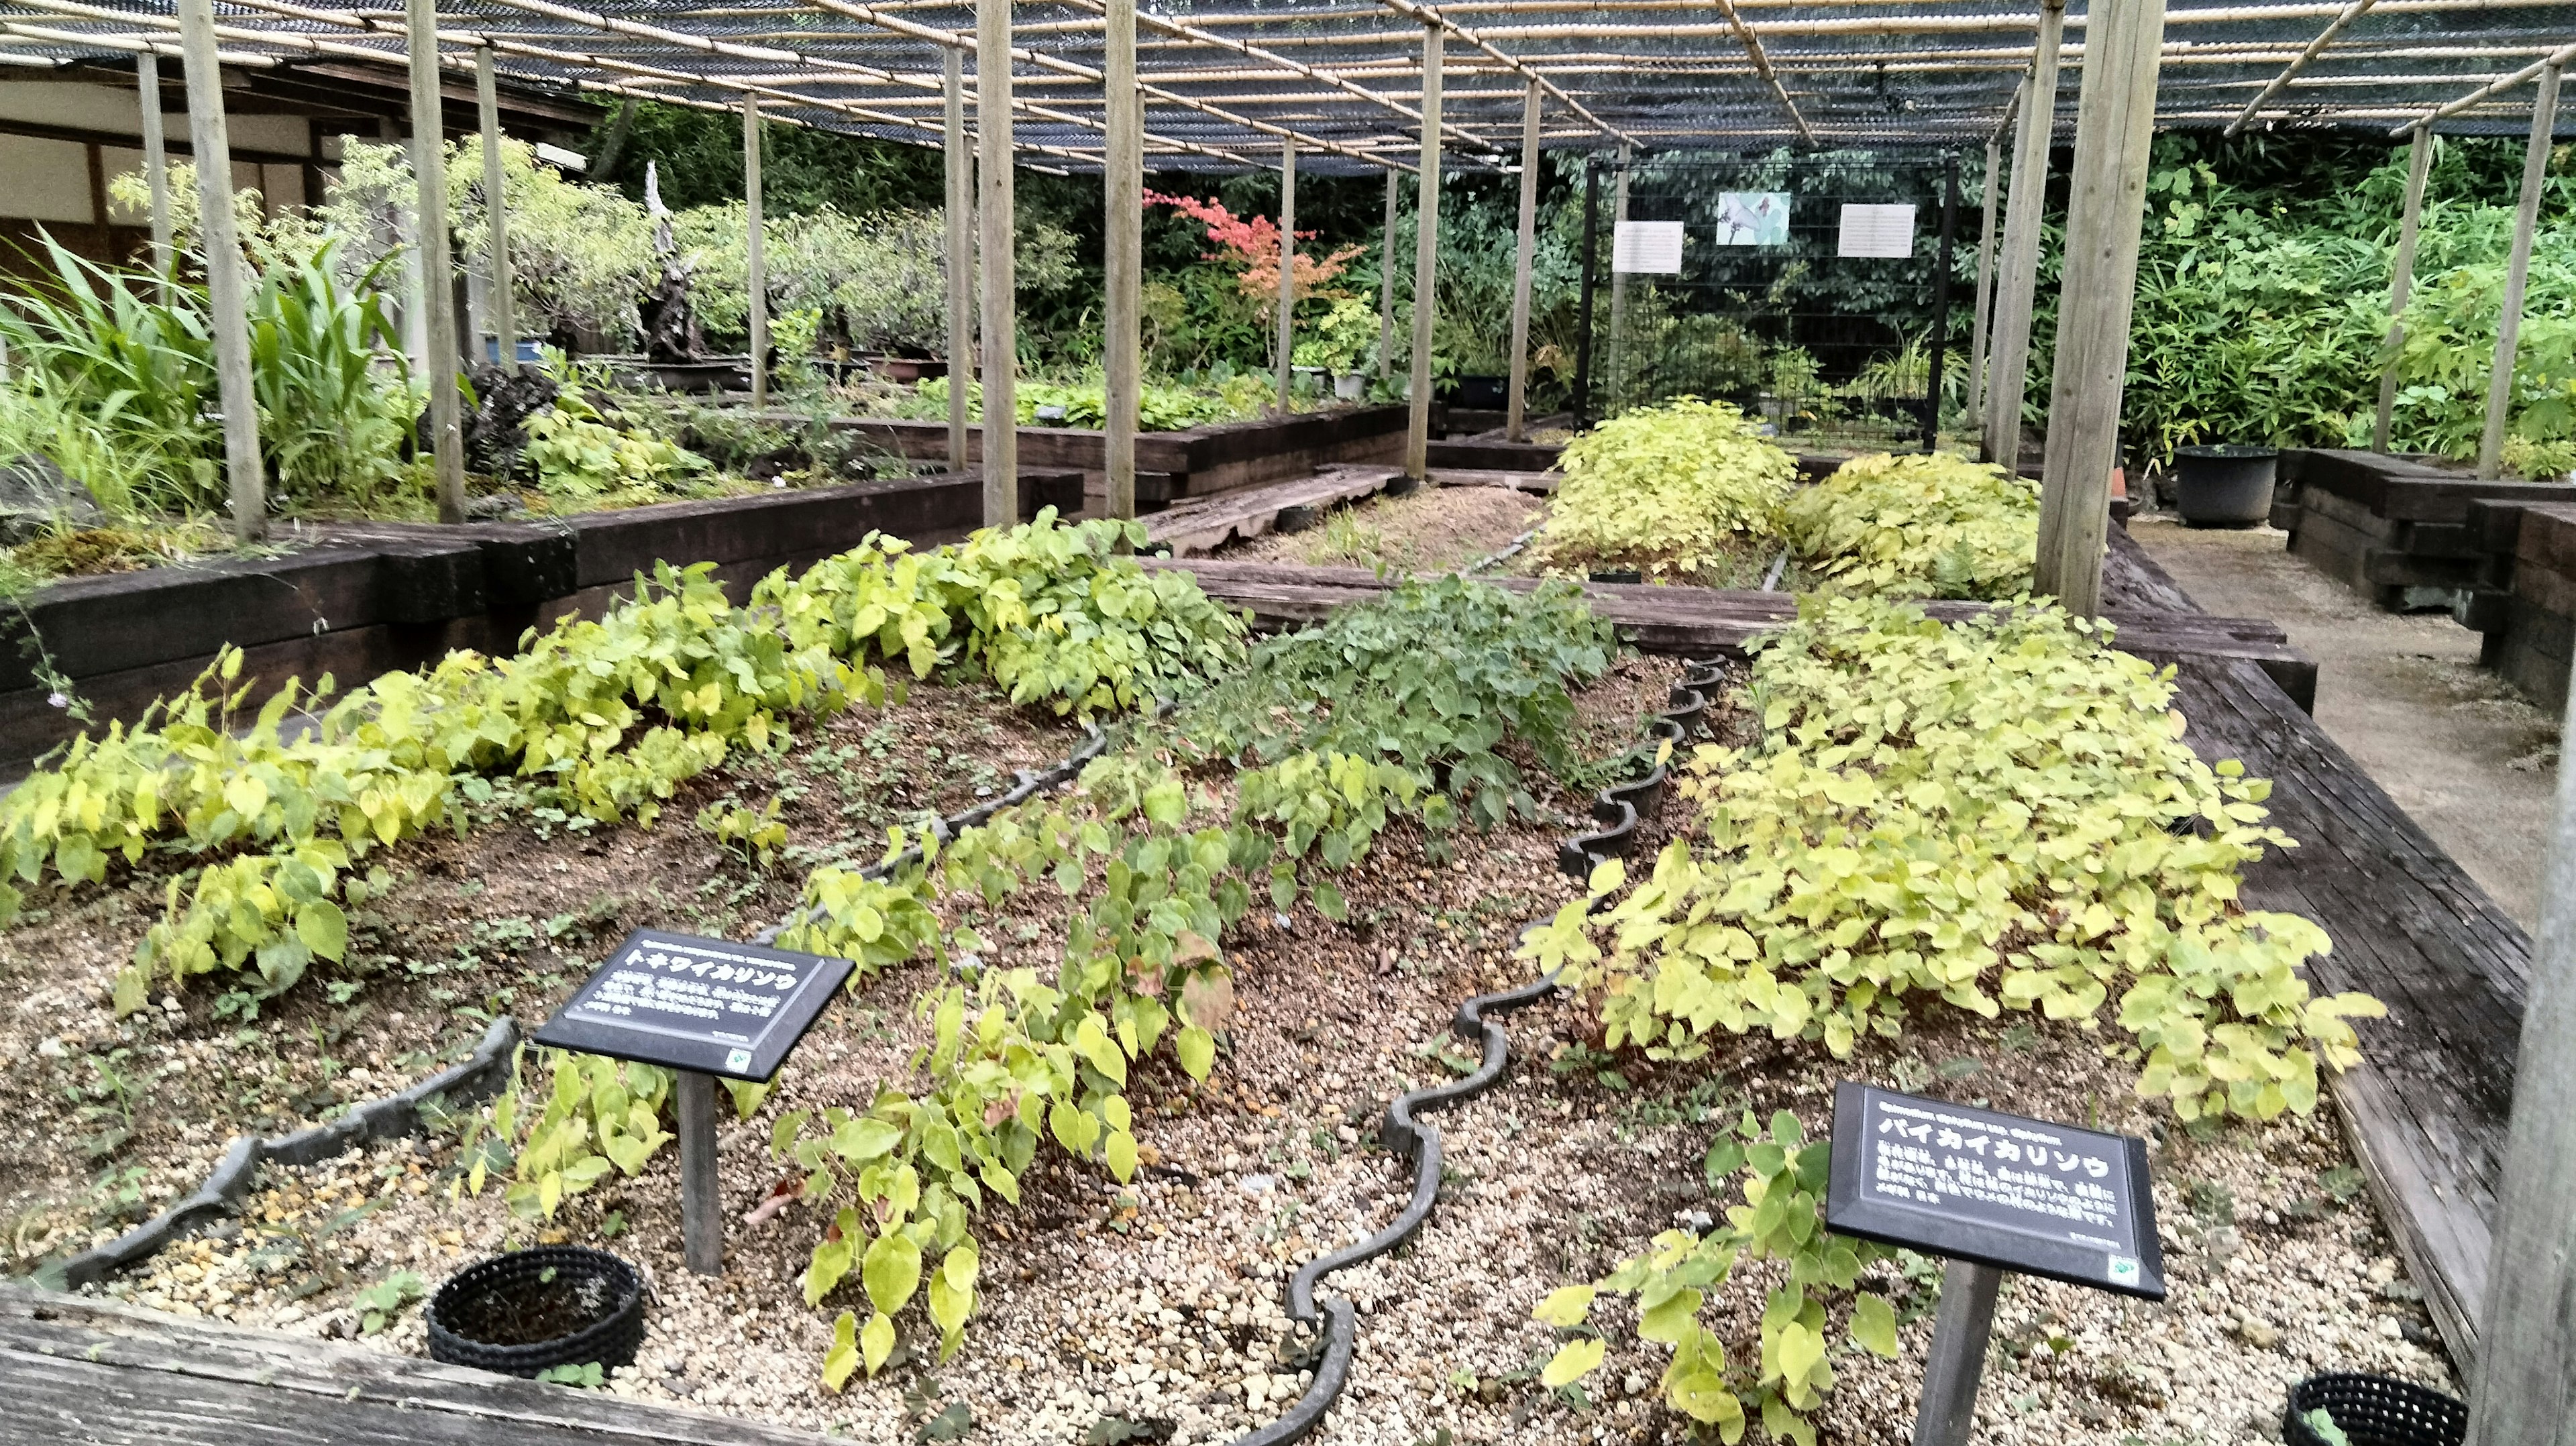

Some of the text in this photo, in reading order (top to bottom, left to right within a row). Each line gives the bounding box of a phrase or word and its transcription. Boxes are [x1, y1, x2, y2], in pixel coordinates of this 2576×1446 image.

[625, 950, 798, 990] トキワイカリソウ
[1879, 1119, 2108, 1177] バイカイカリソウ
